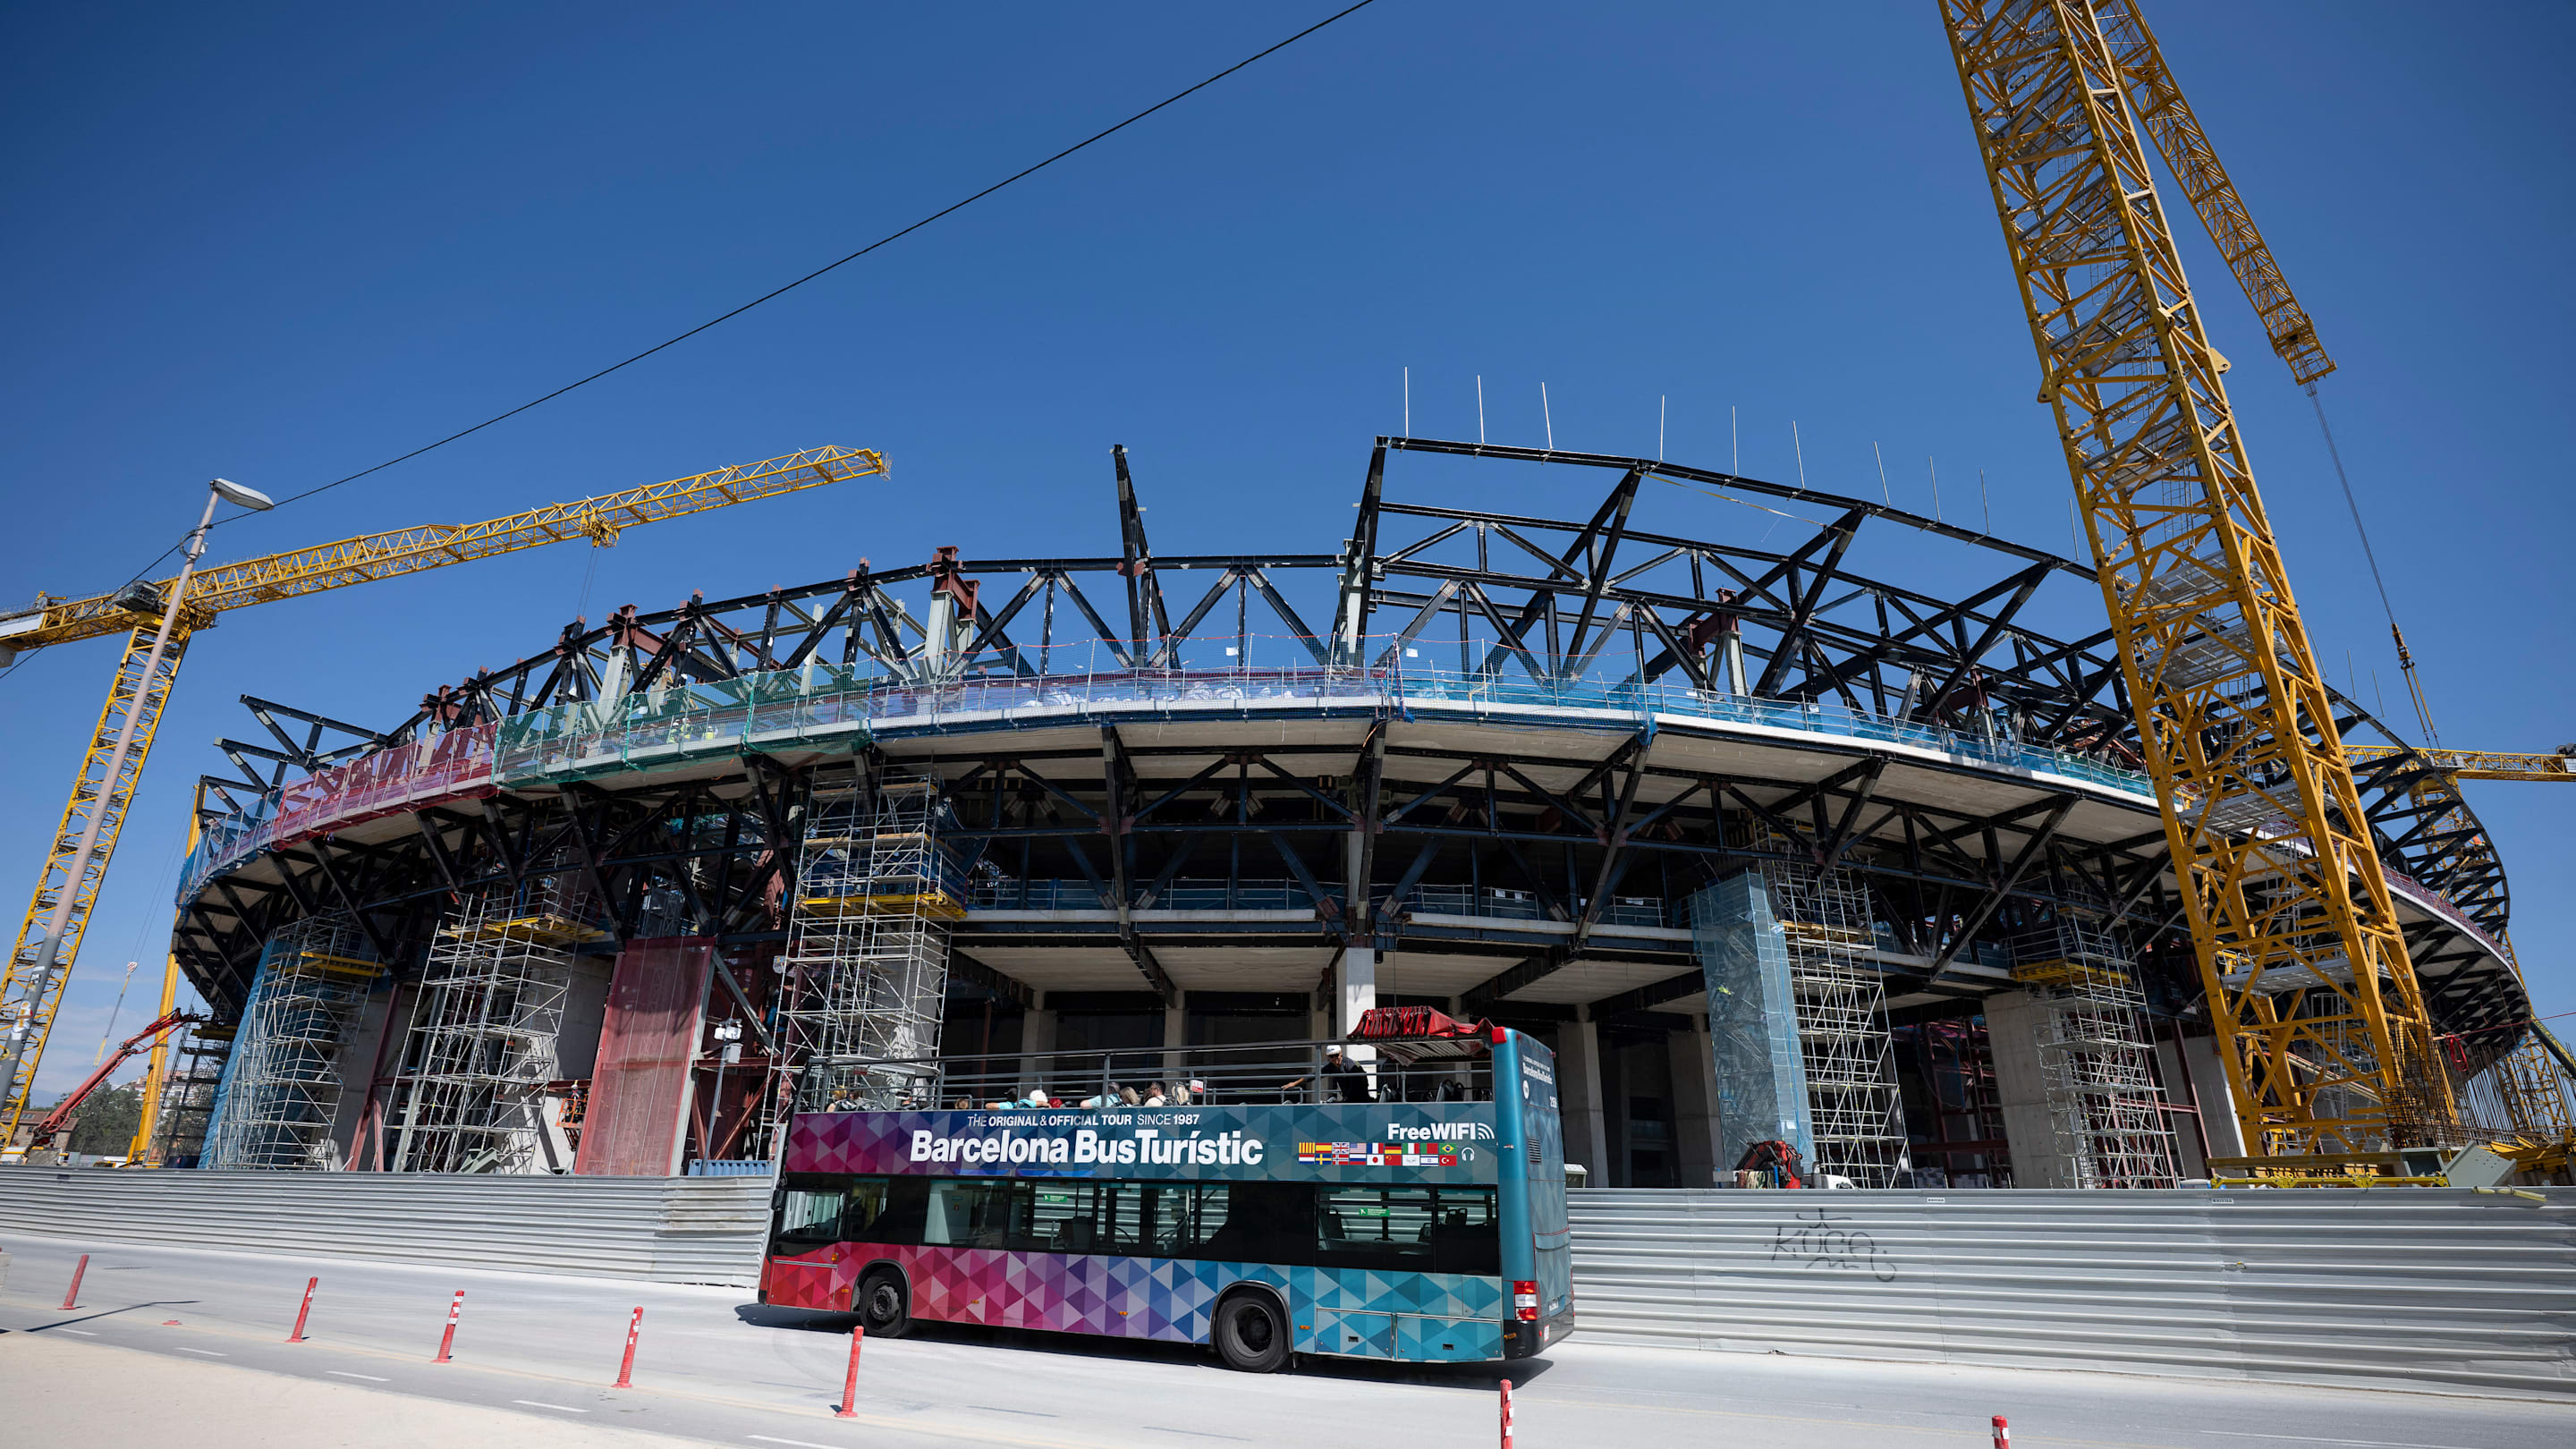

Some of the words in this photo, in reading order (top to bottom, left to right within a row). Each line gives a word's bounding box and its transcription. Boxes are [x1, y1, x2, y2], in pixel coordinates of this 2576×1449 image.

[968, 1115, 987, 1127] THE
[988, 1115, 1038, 1127] ORIGINAL
[1039, 1115, 1047, 1126] &
[1048, 1114, 1098, 1126] OFFICIAL
[1101, 1114, 1132, 1126] TOUR
[1137, 1114, 1171, 1125] SINCE
[1173, 1114, 1200, 1125] 1987
[1387, 1123, 1476, 1140] FreeWIFI
[910, 1130, 1069, 1163] Barcelona
[1074, 1130, 1264, 1165] BusTurístic
